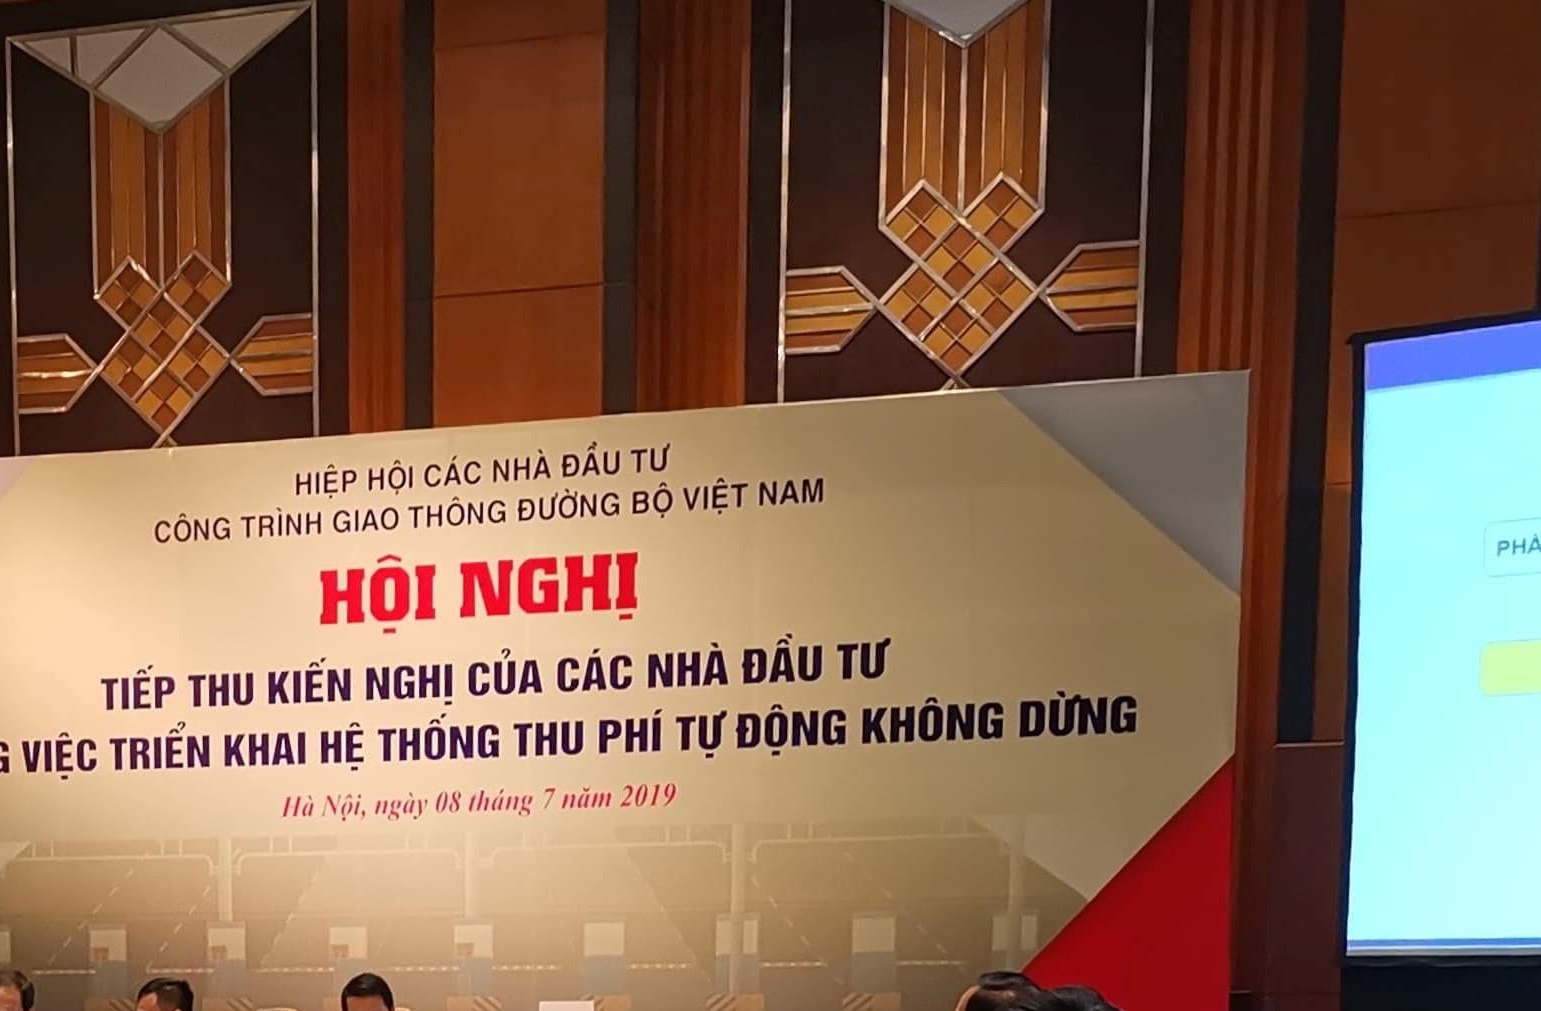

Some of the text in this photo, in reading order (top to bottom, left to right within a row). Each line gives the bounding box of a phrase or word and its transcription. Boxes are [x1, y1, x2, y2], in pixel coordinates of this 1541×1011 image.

[295, 440, 671, 499] HIỆP HỘI CÁC NHÀ ĐẦU TƯ
[154, 477, 824, 544] CÔNG TRÌNH GIAO THÔNG ĐƯỜNG BỘ VIỆT NAM
[319, 551, 639, 634] HỘI NGHỊ
[100, 633, 892, 711] TIẾP THU KIẾN NGHỊ CỦA CÁC NHÀ ĐẦU TƯ
[21, 732, 97, 781] VIỆC
[109, 721, 211, 771] TRIỂN
[224, 731, 306, 767] KHAI
[320, 721, 365, 772] HỆ
[377, 712, 500, 762] THỐNG
[513, 720, 584, 757] THU
[598, 708, 663, 754] PHÍ
[675, 710, 728, 759] TỰ
[735, 703, 847, 757] ĐỘNG
[861, 696, 1004, 745] KHÔNG
[1019, 690, 1138, 738] DỪNG
[282, 783, 677, 822] Hà Nội, ngày 08 tháng 7 năm 2019
